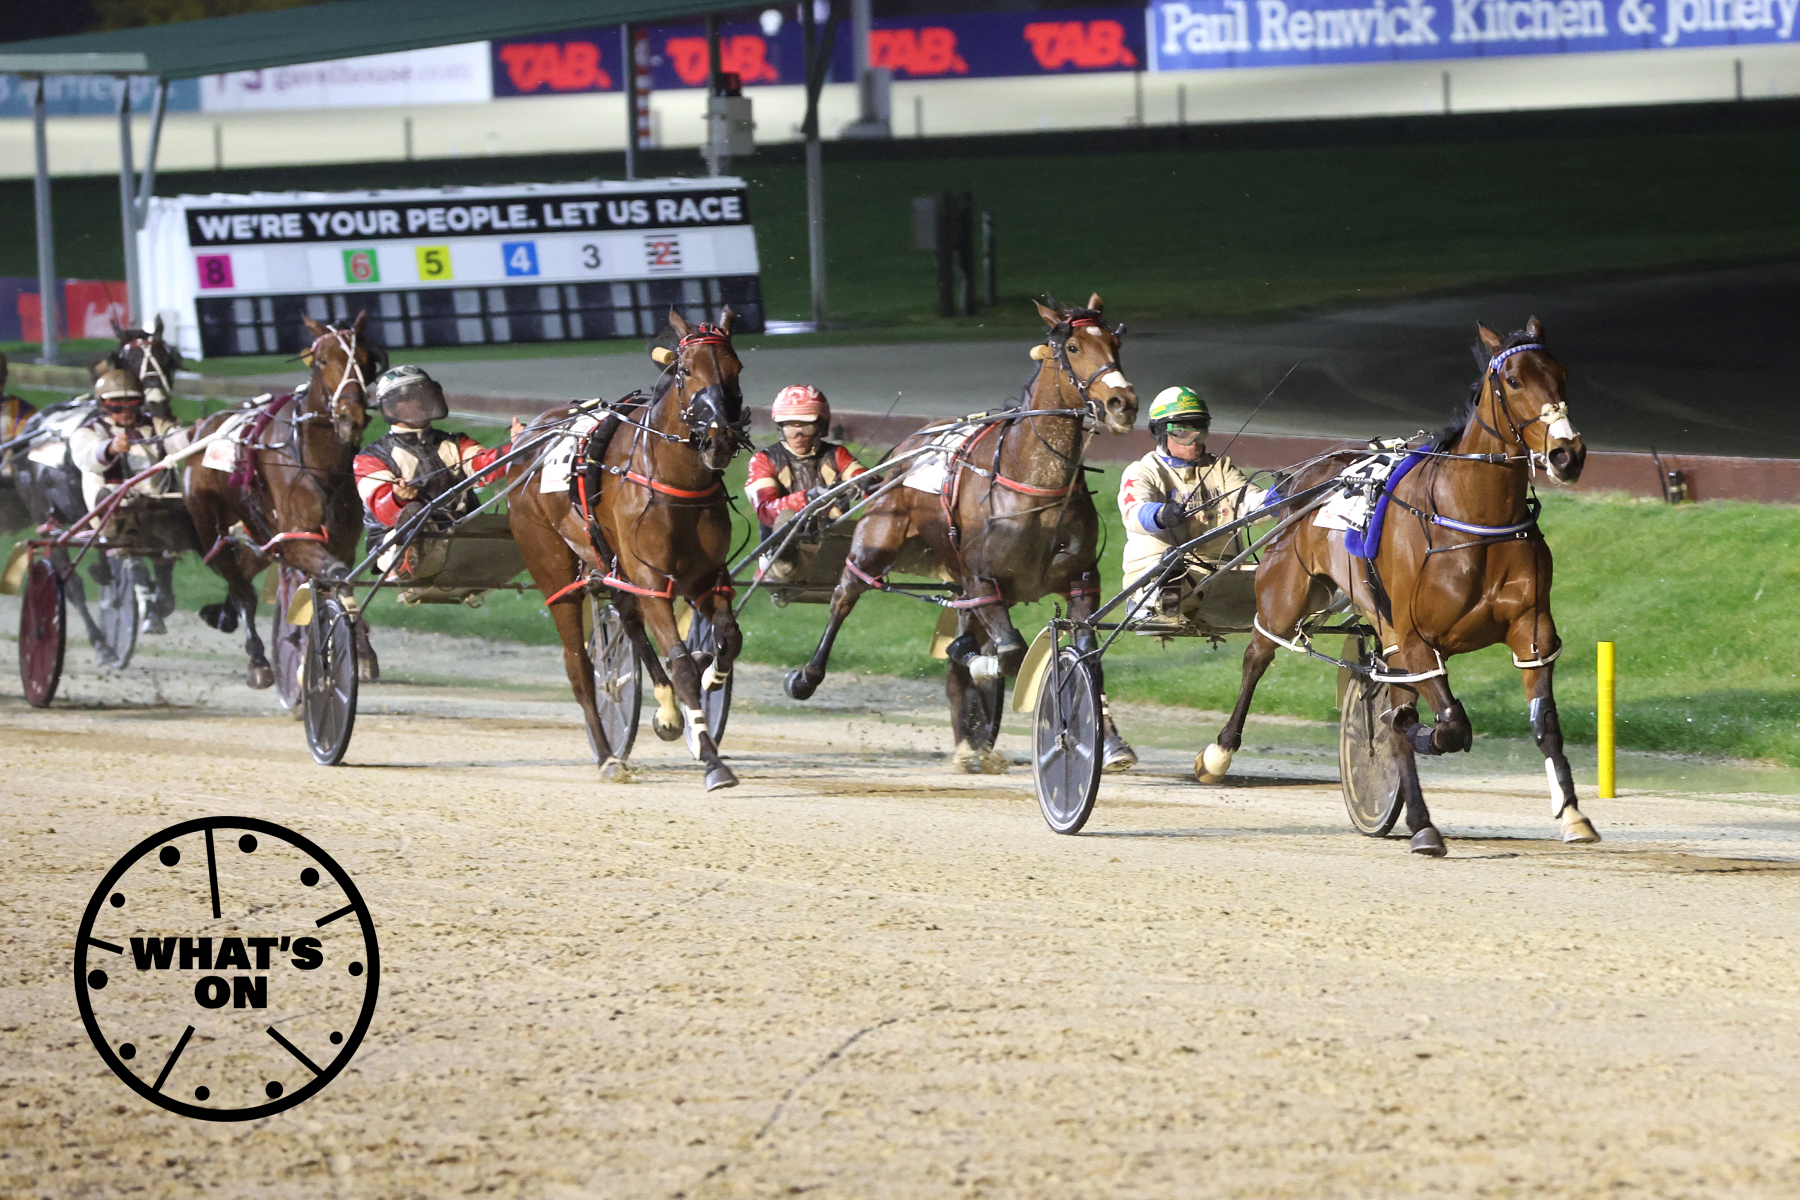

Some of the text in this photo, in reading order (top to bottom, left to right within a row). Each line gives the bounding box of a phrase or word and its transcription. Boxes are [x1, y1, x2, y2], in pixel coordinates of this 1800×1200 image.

[1161, 0, 1251, 55] Paul
[1257, 0, 1439, 50] Renwick
[1449, 0, 1608, 44] Kitchen
[197, 196, 743, 241] WE'RE YOUR PEOPLE. LET US RACE
[204, 242, 674, 285] 8 6 5 4 3 2
